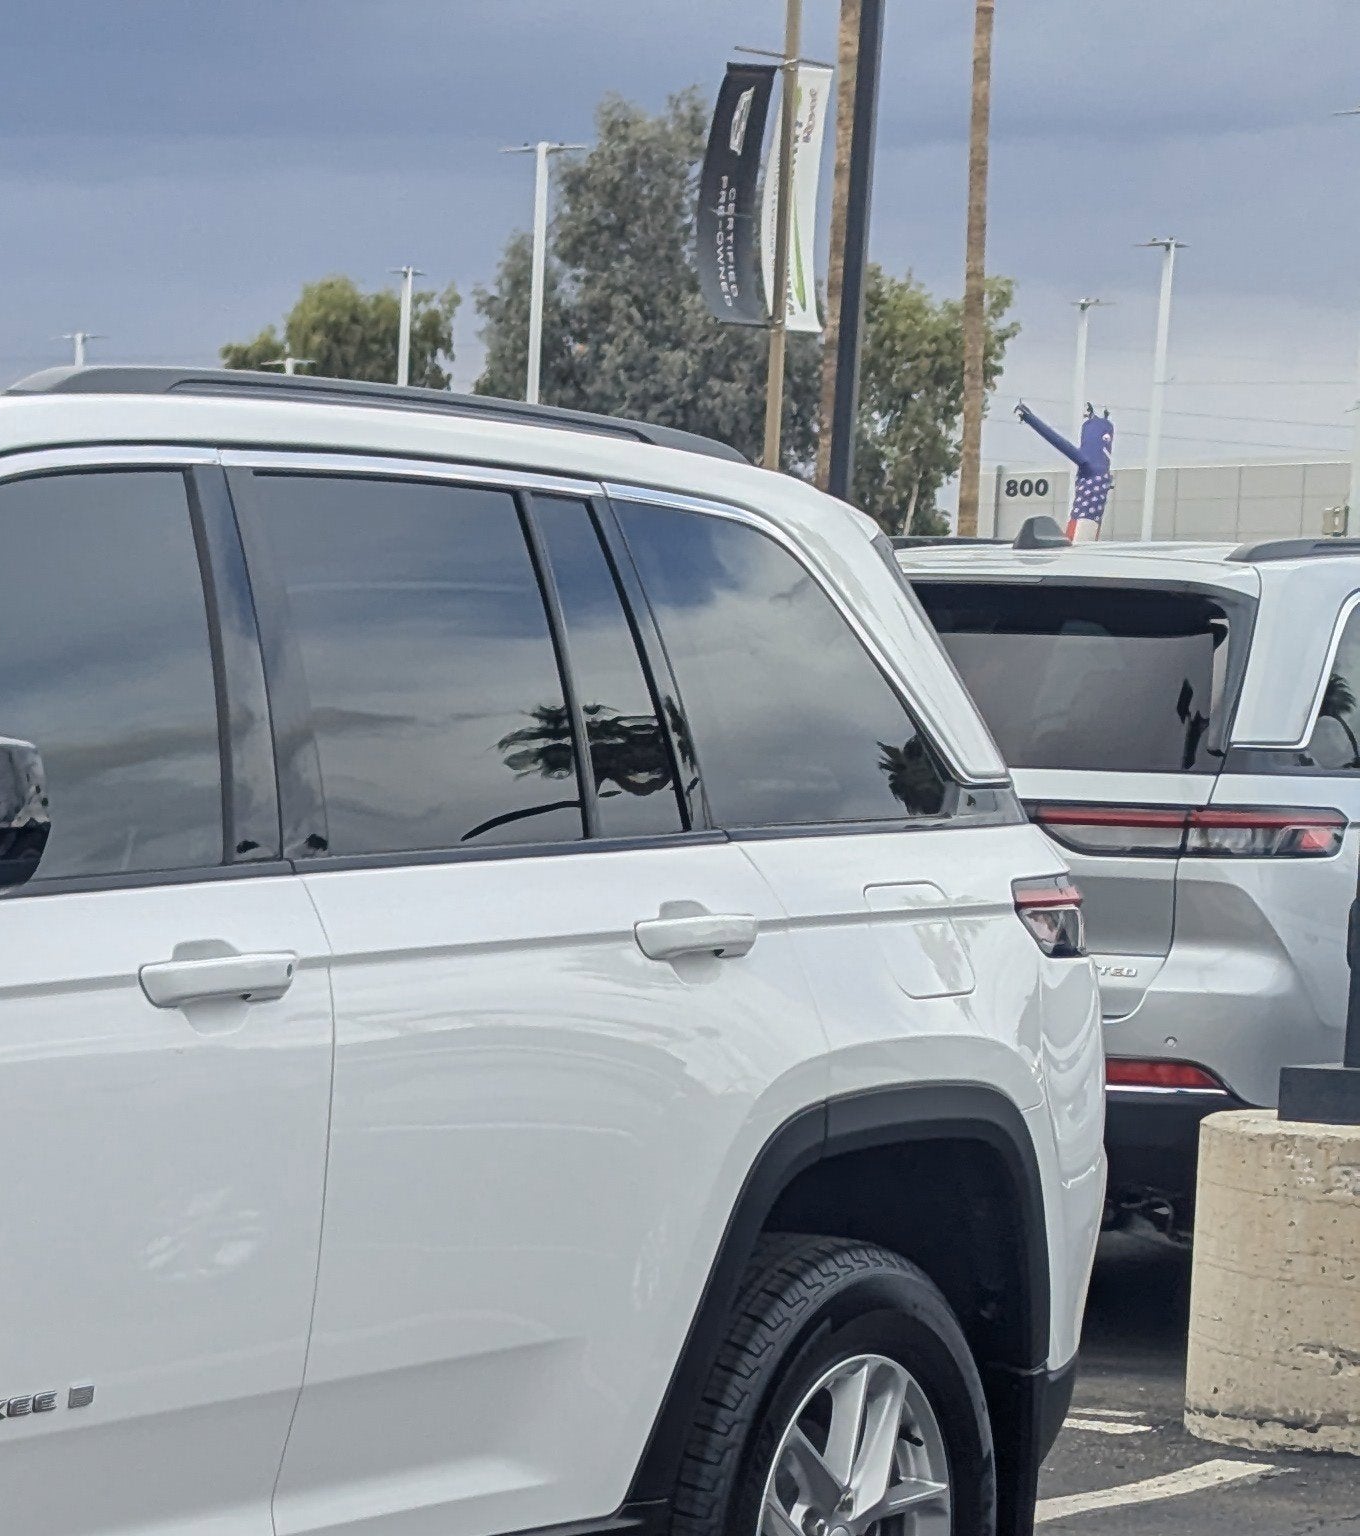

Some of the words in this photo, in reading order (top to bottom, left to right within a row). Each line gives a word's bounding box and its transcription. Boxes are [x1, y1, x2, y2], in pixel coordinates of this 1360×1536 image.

[726, 187, 739, 298] CERTIFIED
[1005, 478, 1049, 498] 800
[1096, 965, 1138, 978] TED
